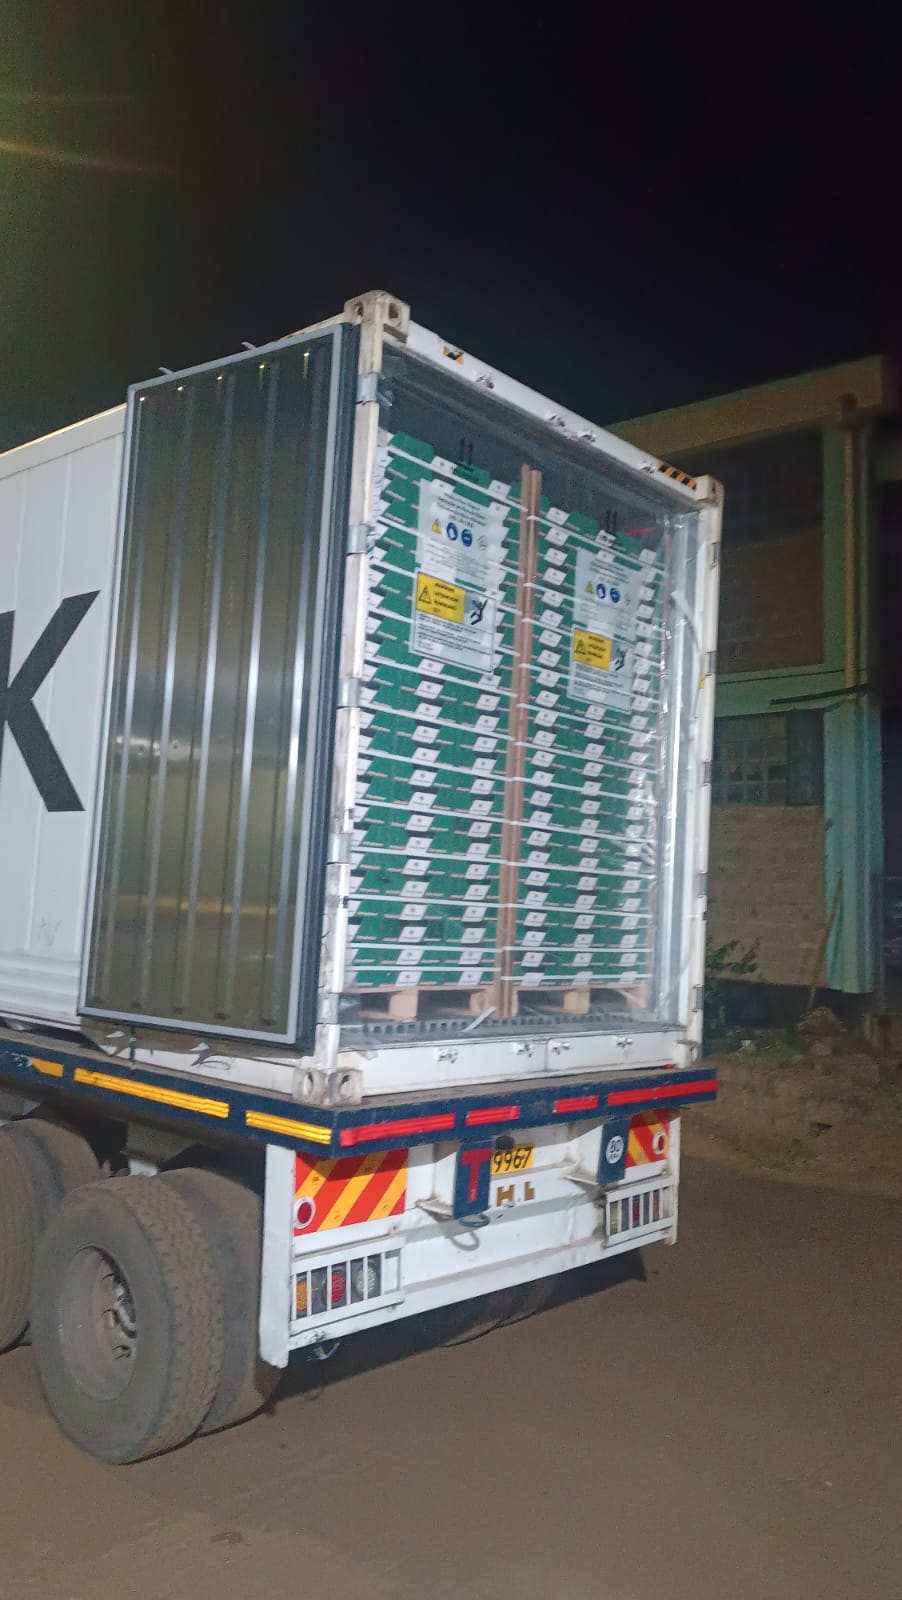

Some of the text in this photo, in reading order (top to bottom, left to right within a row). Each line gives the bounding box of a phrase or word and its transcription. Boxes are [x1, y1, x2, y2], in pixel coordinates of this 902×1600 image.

[0, 590, 101, 812] K
[461, 1148, 491, 1203] T
[493, 1146, 532, 1173] 9967
